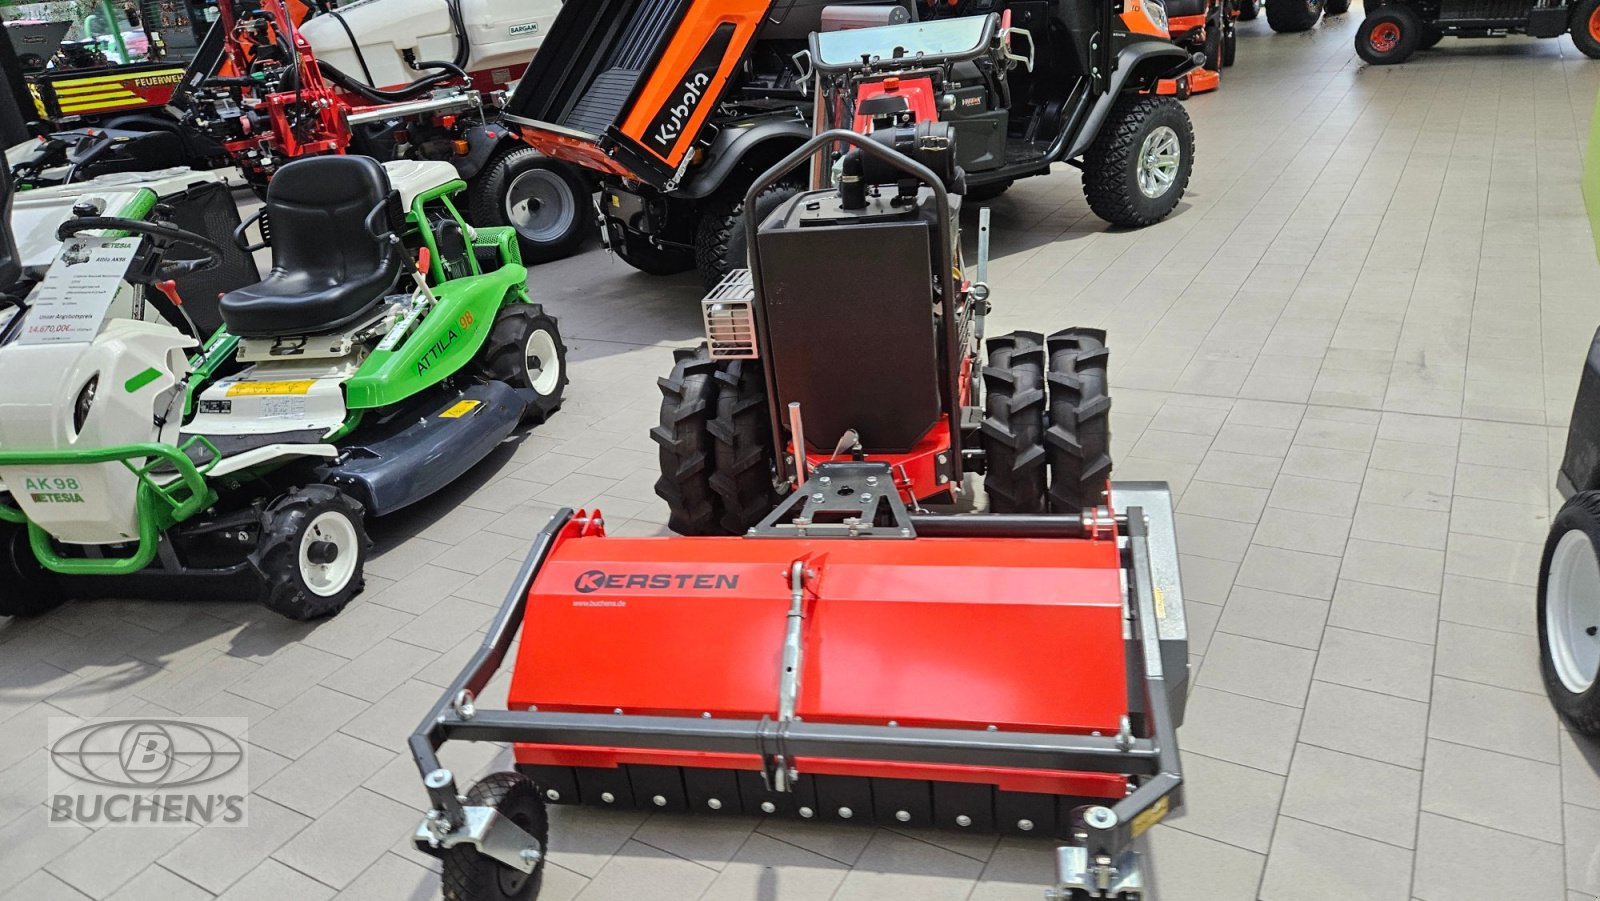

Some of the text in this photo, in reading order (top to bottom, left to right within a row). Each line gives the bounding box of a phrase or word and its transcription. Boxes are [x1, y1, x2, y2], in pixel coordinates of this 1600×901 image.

[510, 24, 537, 34] BARGAM
[135, 74, 184, 87] FEUERWEH
[654, 72, 709, 146] Kubota
[417, 310, 474, 377] ATTILA 98
[25, 478, 79, 490] AK 98
[30, 492, 85, 503] ETESIA
[574, 570, 740, 593] KERSTEN
